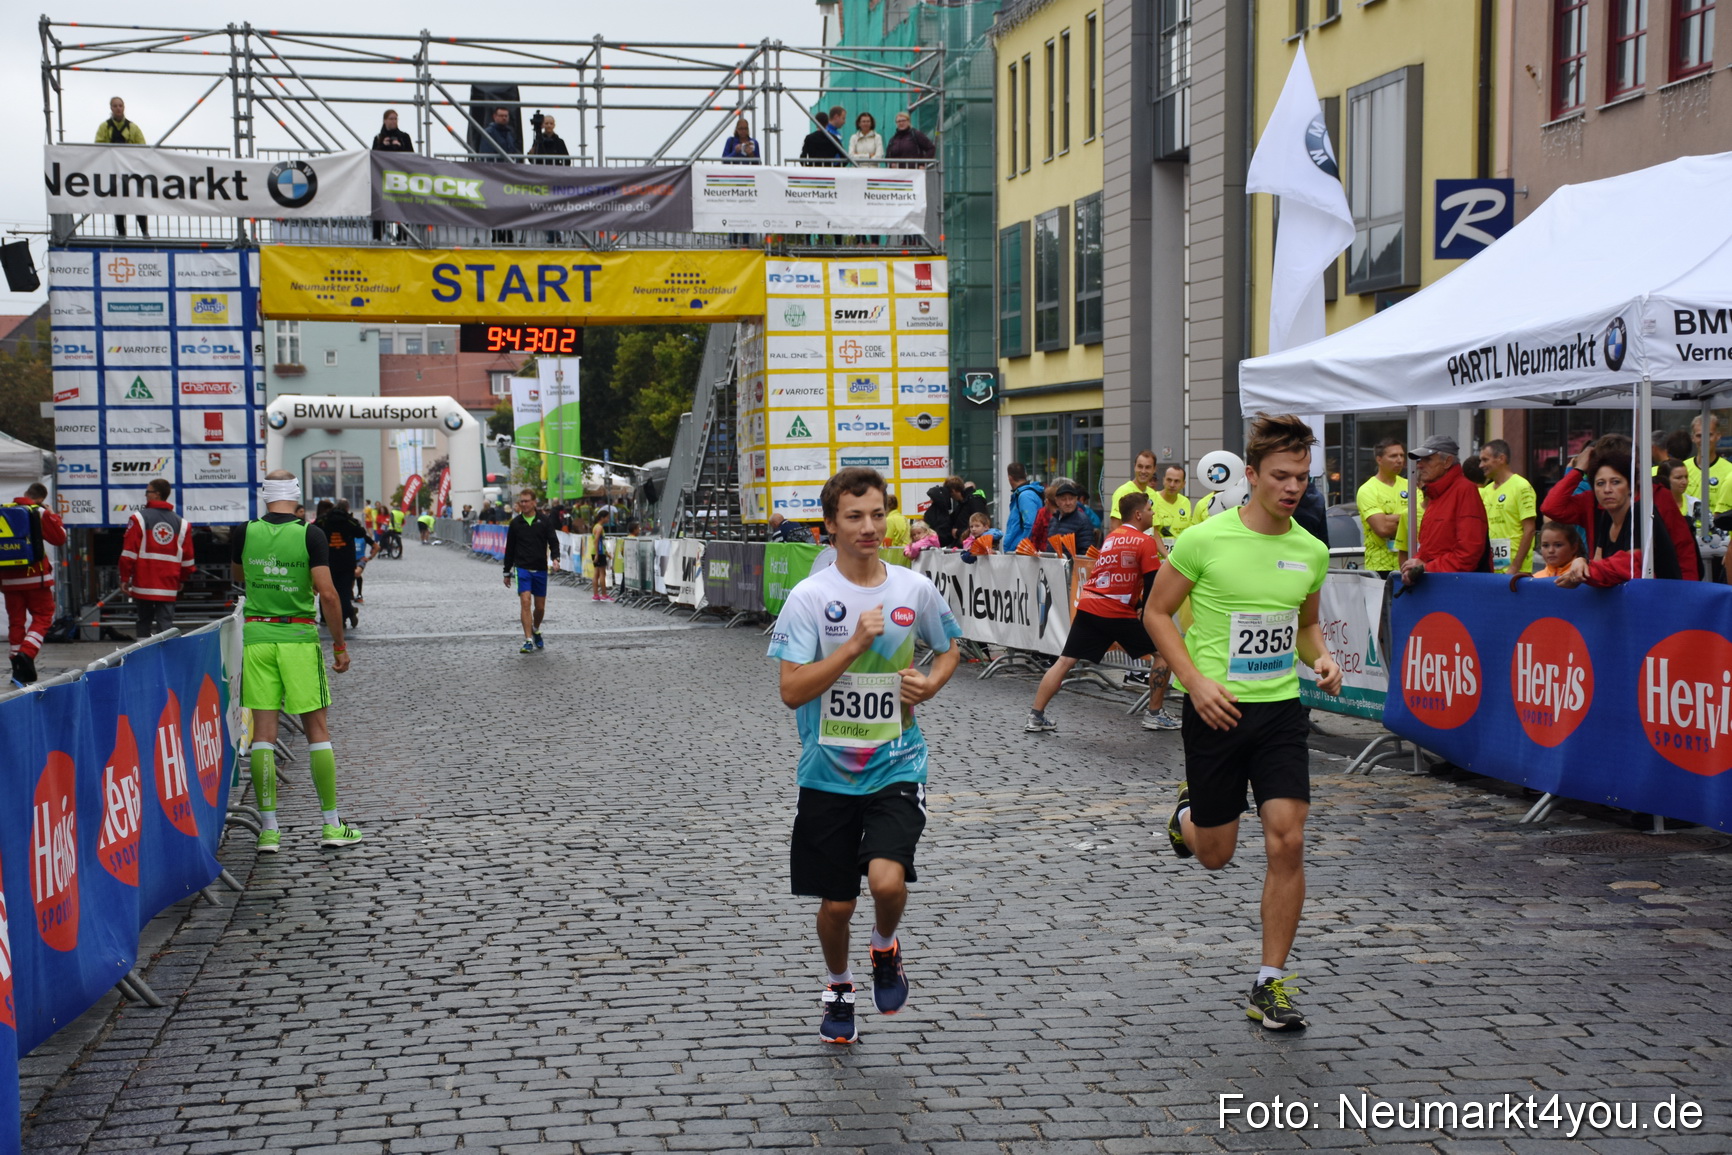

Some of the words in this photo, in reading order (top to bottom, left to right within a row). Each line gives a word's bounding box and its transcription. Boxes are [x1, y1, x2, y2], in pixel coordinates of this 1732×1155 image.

[384, 173, 482, 199] BOCK
[503, 184, 549, 196] OFFICE
[703, 188, 758, 197] NeuerMarkt
[785, 189, 838, 199] NeuerMarkt
[864, 191, 917, 201] NeuerMarkt
[529, 200, 651, 213] www.bockonline.de
[290, 281, 350, 293] Neumarkter
[354, 282, 400, 294] Stadtlauf
[431, 263, 602, 303] START
[632, 284, 689, 296] Neumarkter
[692, 284, 737, 296] Stadtlauf
[834, 309, 868, 319] swn
[1674, 308, 1732, 336] BM
[487, 326, 575, 352] 9:43:02
[123, 346, 168, 354] VARIOTEC
[1447, 345, 1502, 386] PARTL
[1506, 333, 1597, 378] Neumarkt
[785, 388, 824, 396] VARIOTEC
[294, 404, 344, 418] BMW
[350, 404, 438, 422] Laufsport
[112, 460, 150, 471] swn
[403, 478, 420, 505] REWE
[1238, 626, 1294, 654] 2353
[1248, 659, 1283, 672] Valentin
[1405, 636, 1478, 707] Hervis
[1516, 642, 1585, 723] Hervis
[830, 690, 894, 720] 5306
[1410, 696, 1446, 711] SPORTS
[1646, 656, 1732, 749] Hervi
[1522, 709, 1553, 727] SPORTS
[825, 721, 870, 737] Leander
[1655, 731, 1710, 753] SPORTS
